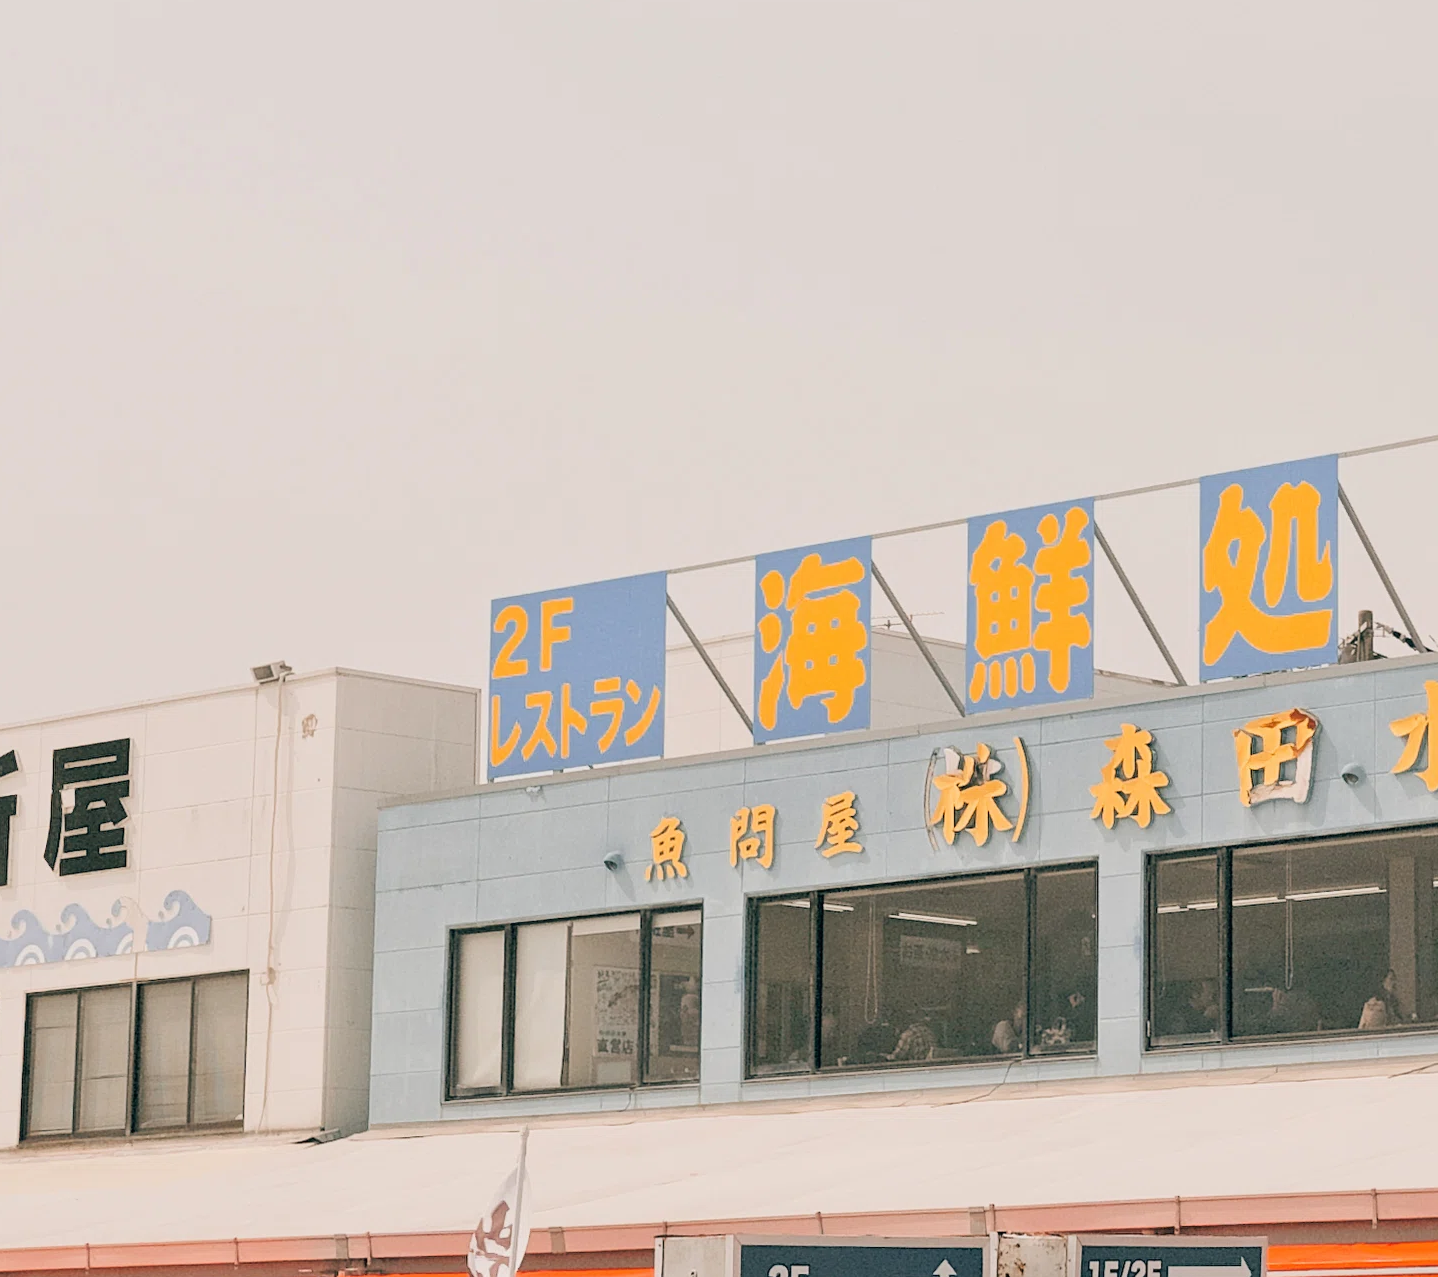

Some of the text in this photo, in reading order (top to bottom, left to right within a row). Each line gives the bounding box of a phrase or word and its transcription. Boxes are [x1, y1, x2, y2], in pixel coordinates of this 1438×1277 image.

[492, 597, 574, 680] 2F
[488, 676, 664, 770] レストラン
[644, 791, 865, 883] 魚問屋
